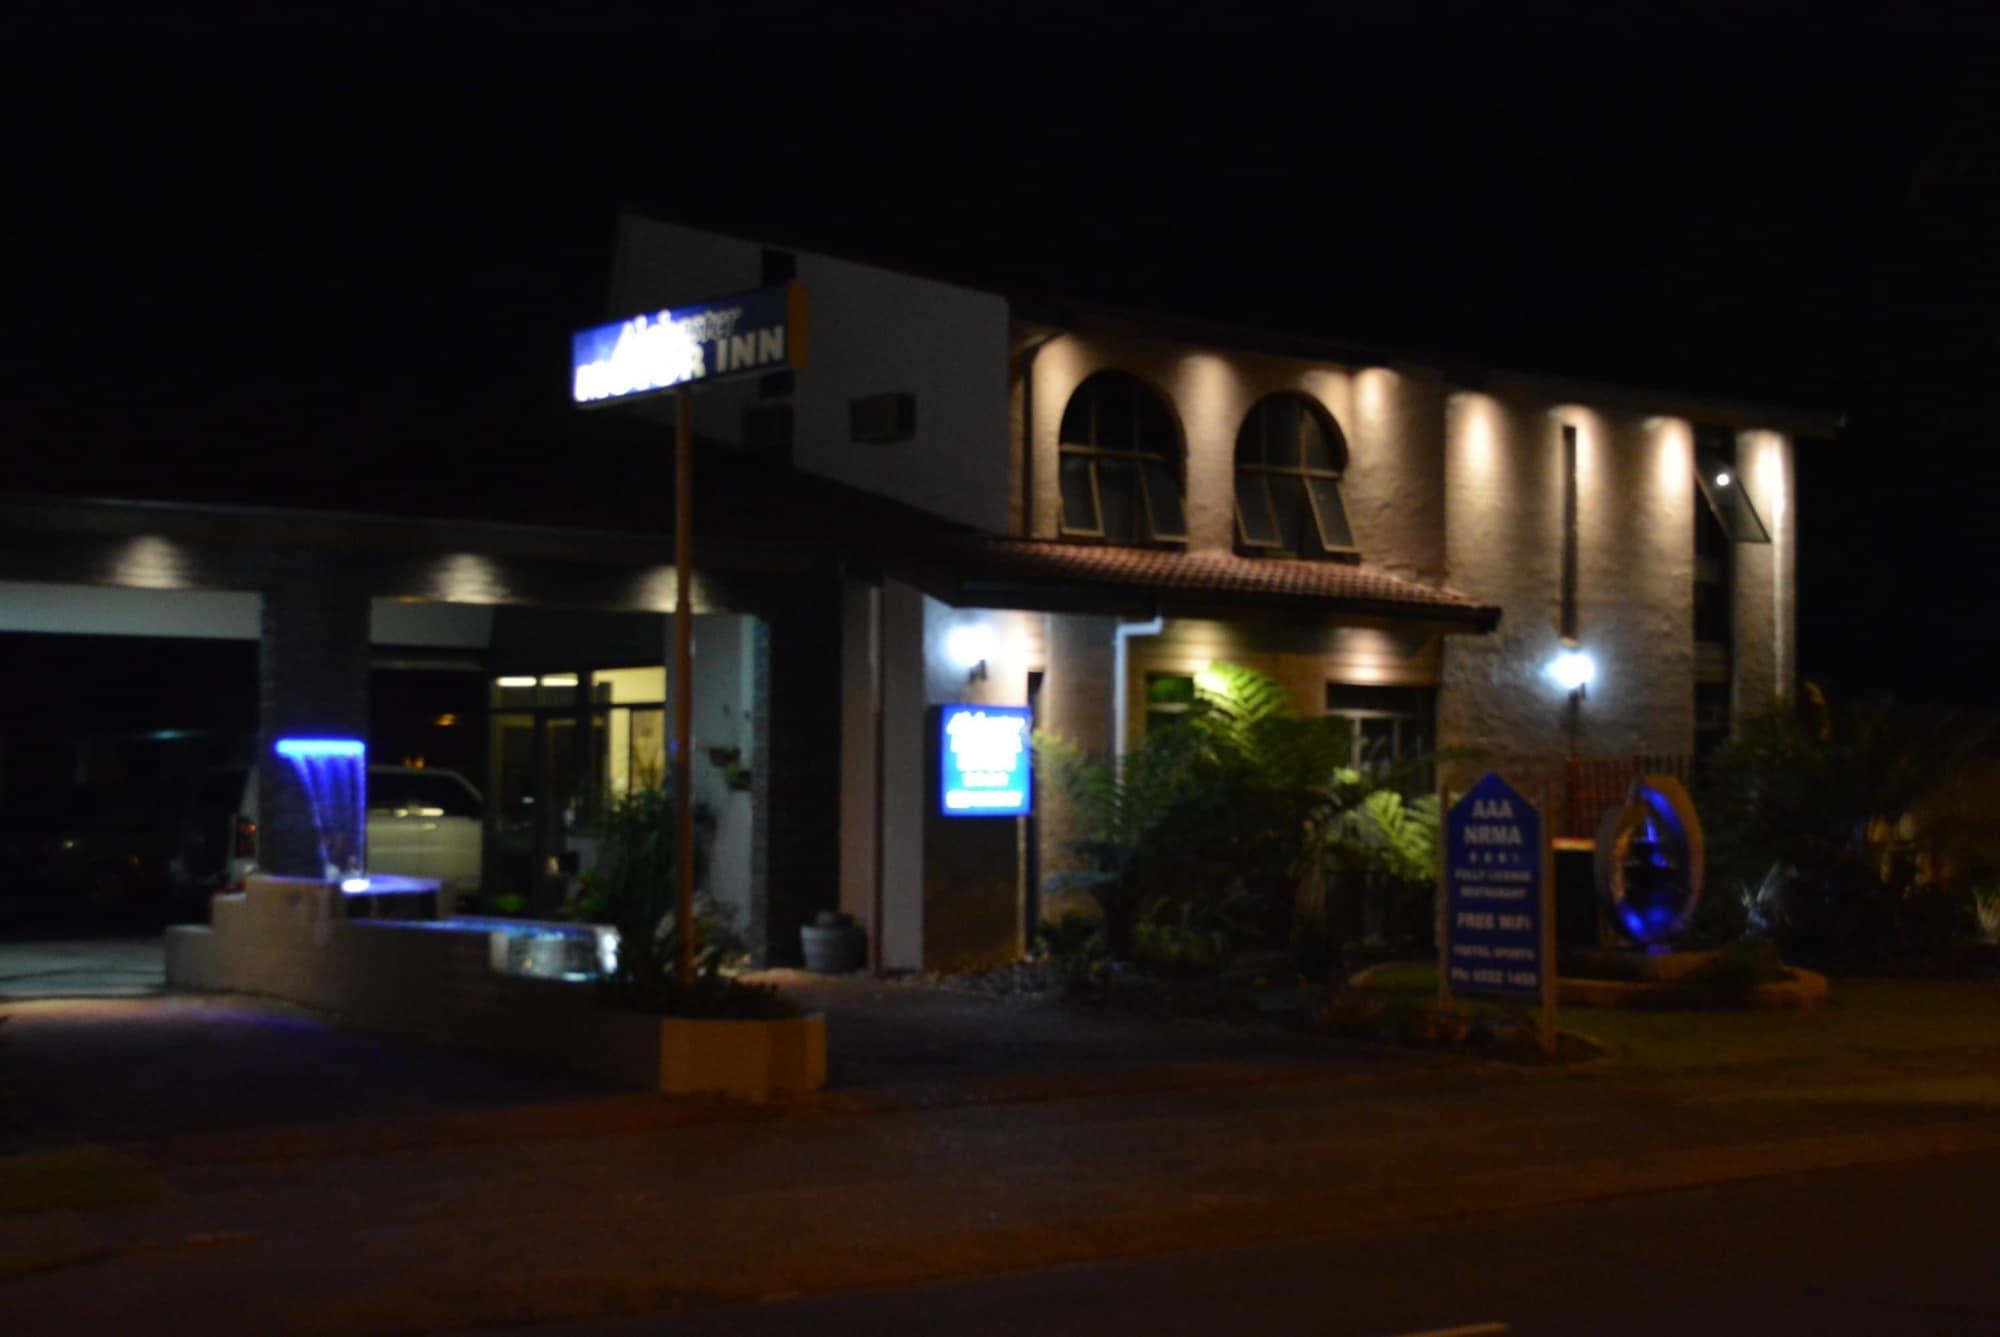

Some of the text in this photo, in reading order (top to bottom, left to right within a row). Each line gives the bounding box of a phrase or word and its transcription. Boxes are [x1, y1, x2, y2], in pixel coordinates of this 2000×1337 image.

[716, 325, 785, 373] INN
[1472, 798, 1513, 819] AAA
[1463, 825, 1522, 845] NRMA
[1456, 911, 1495, 930] FREE
